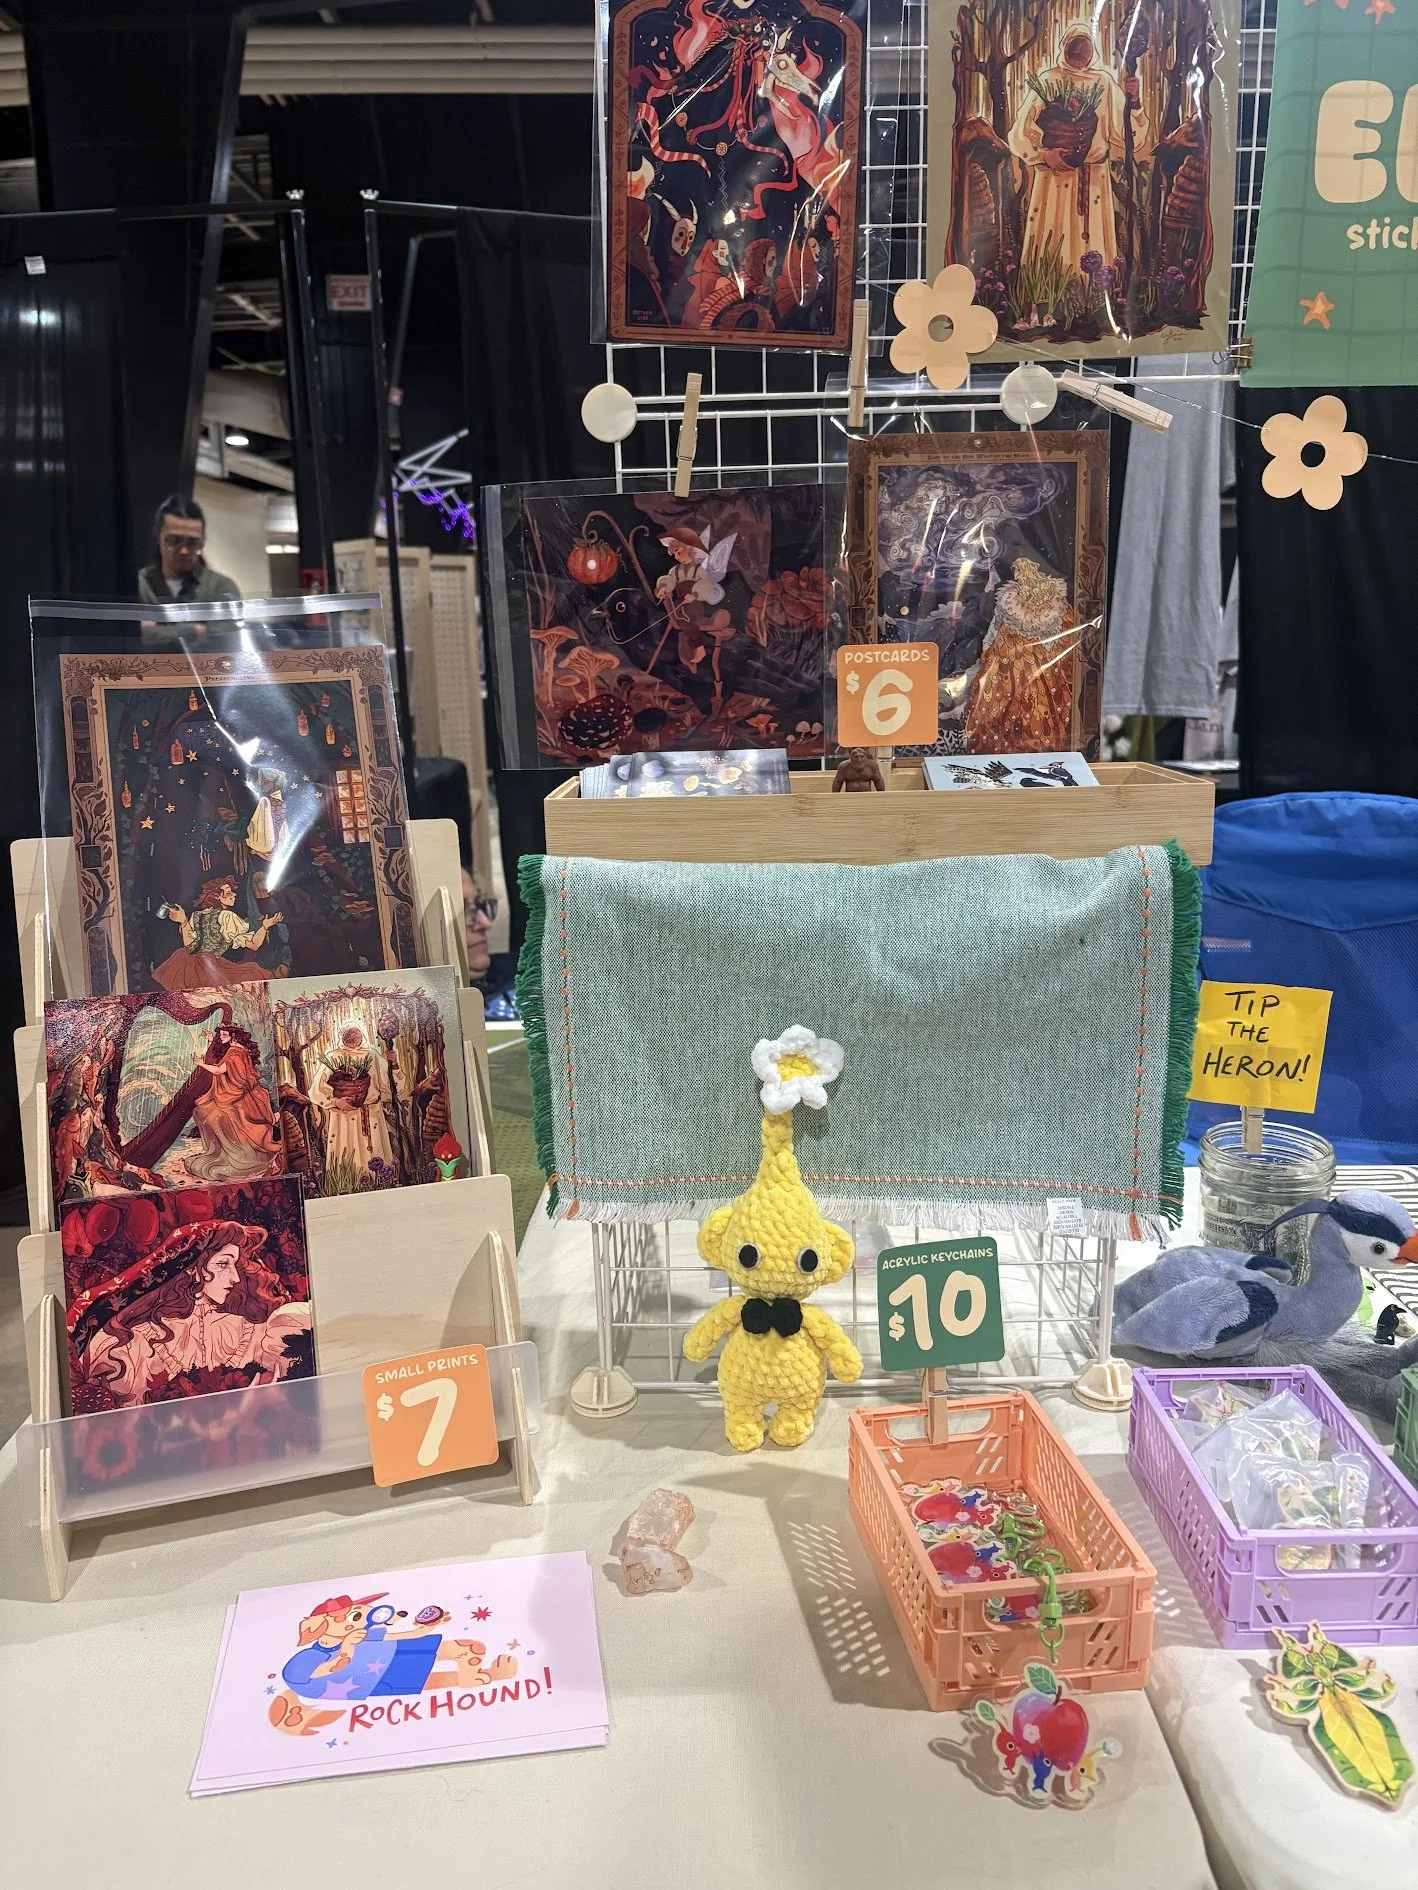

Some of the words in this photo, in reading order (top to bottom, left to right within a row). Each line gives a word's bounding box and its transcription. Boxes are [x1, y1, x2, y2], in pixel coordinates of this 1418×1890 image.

[1314, 80, 1418, 203] E
[331, 284, 368, 298] EXIT
[844, 649, 931, 664] POSTCARDS
[845, 669, 914, 736] $6
[1224, 990, 1280, 1018] TIP
[1226, 1021, 1270, 1043] THE
[1202, 1046, 1311, 1082] HERON!
[882, 1254, 928, 1271] ACRYLIC
[930, 1247, 994, 1264] KEYCHAINS
[888, 1270, 987, 1351] $10
[375, 1364, 425, 1385] SMALL
[427, 1353, 479, 1373] PRINTS
[376, 1377, 458, 1467] $7
